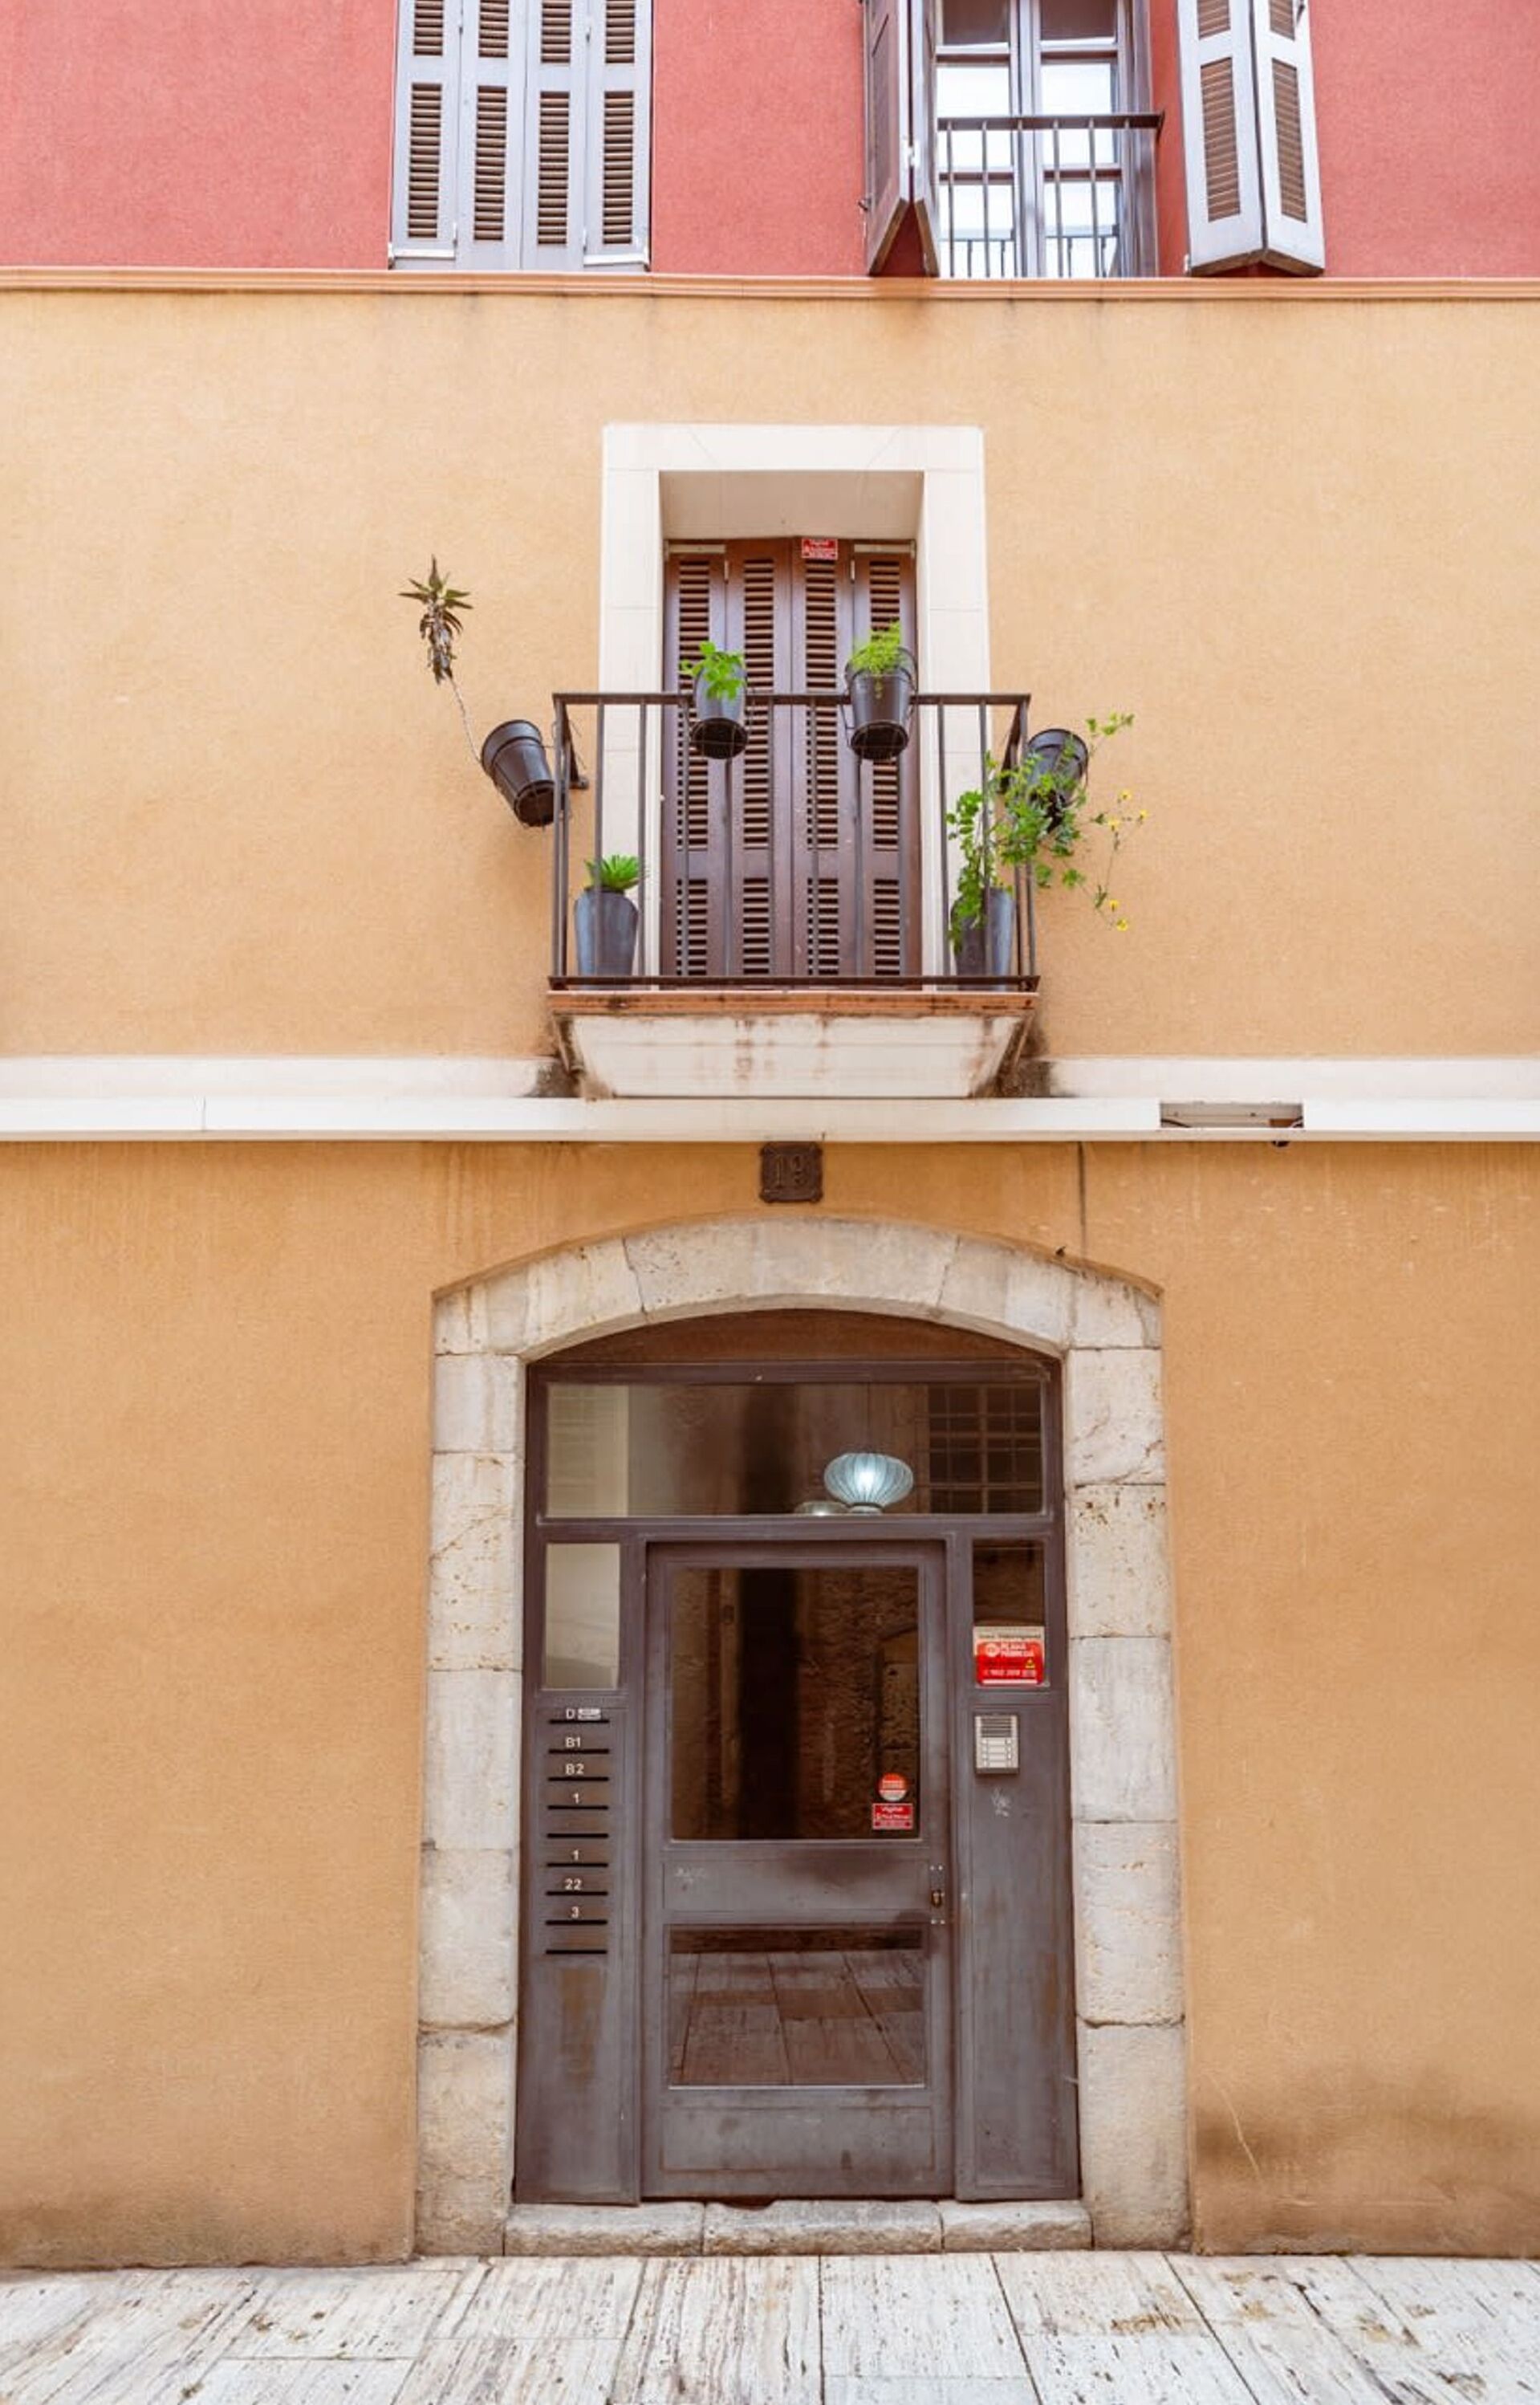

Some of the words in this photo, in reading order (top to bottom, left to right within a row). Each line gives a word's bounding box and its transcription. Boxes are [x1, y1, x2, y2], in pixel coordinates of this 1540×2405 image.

[566, 1708, 575, 1719] D
[566, 1737, 581, 1748] B1
[566, 1764, 584, 1775] B2
[573, 1793, 579, 1804] 1
[572, 1850, 579, 1861] 1
[565, 1878, 582, 1890] 22
[571, 1907, 579, 1919] 3
